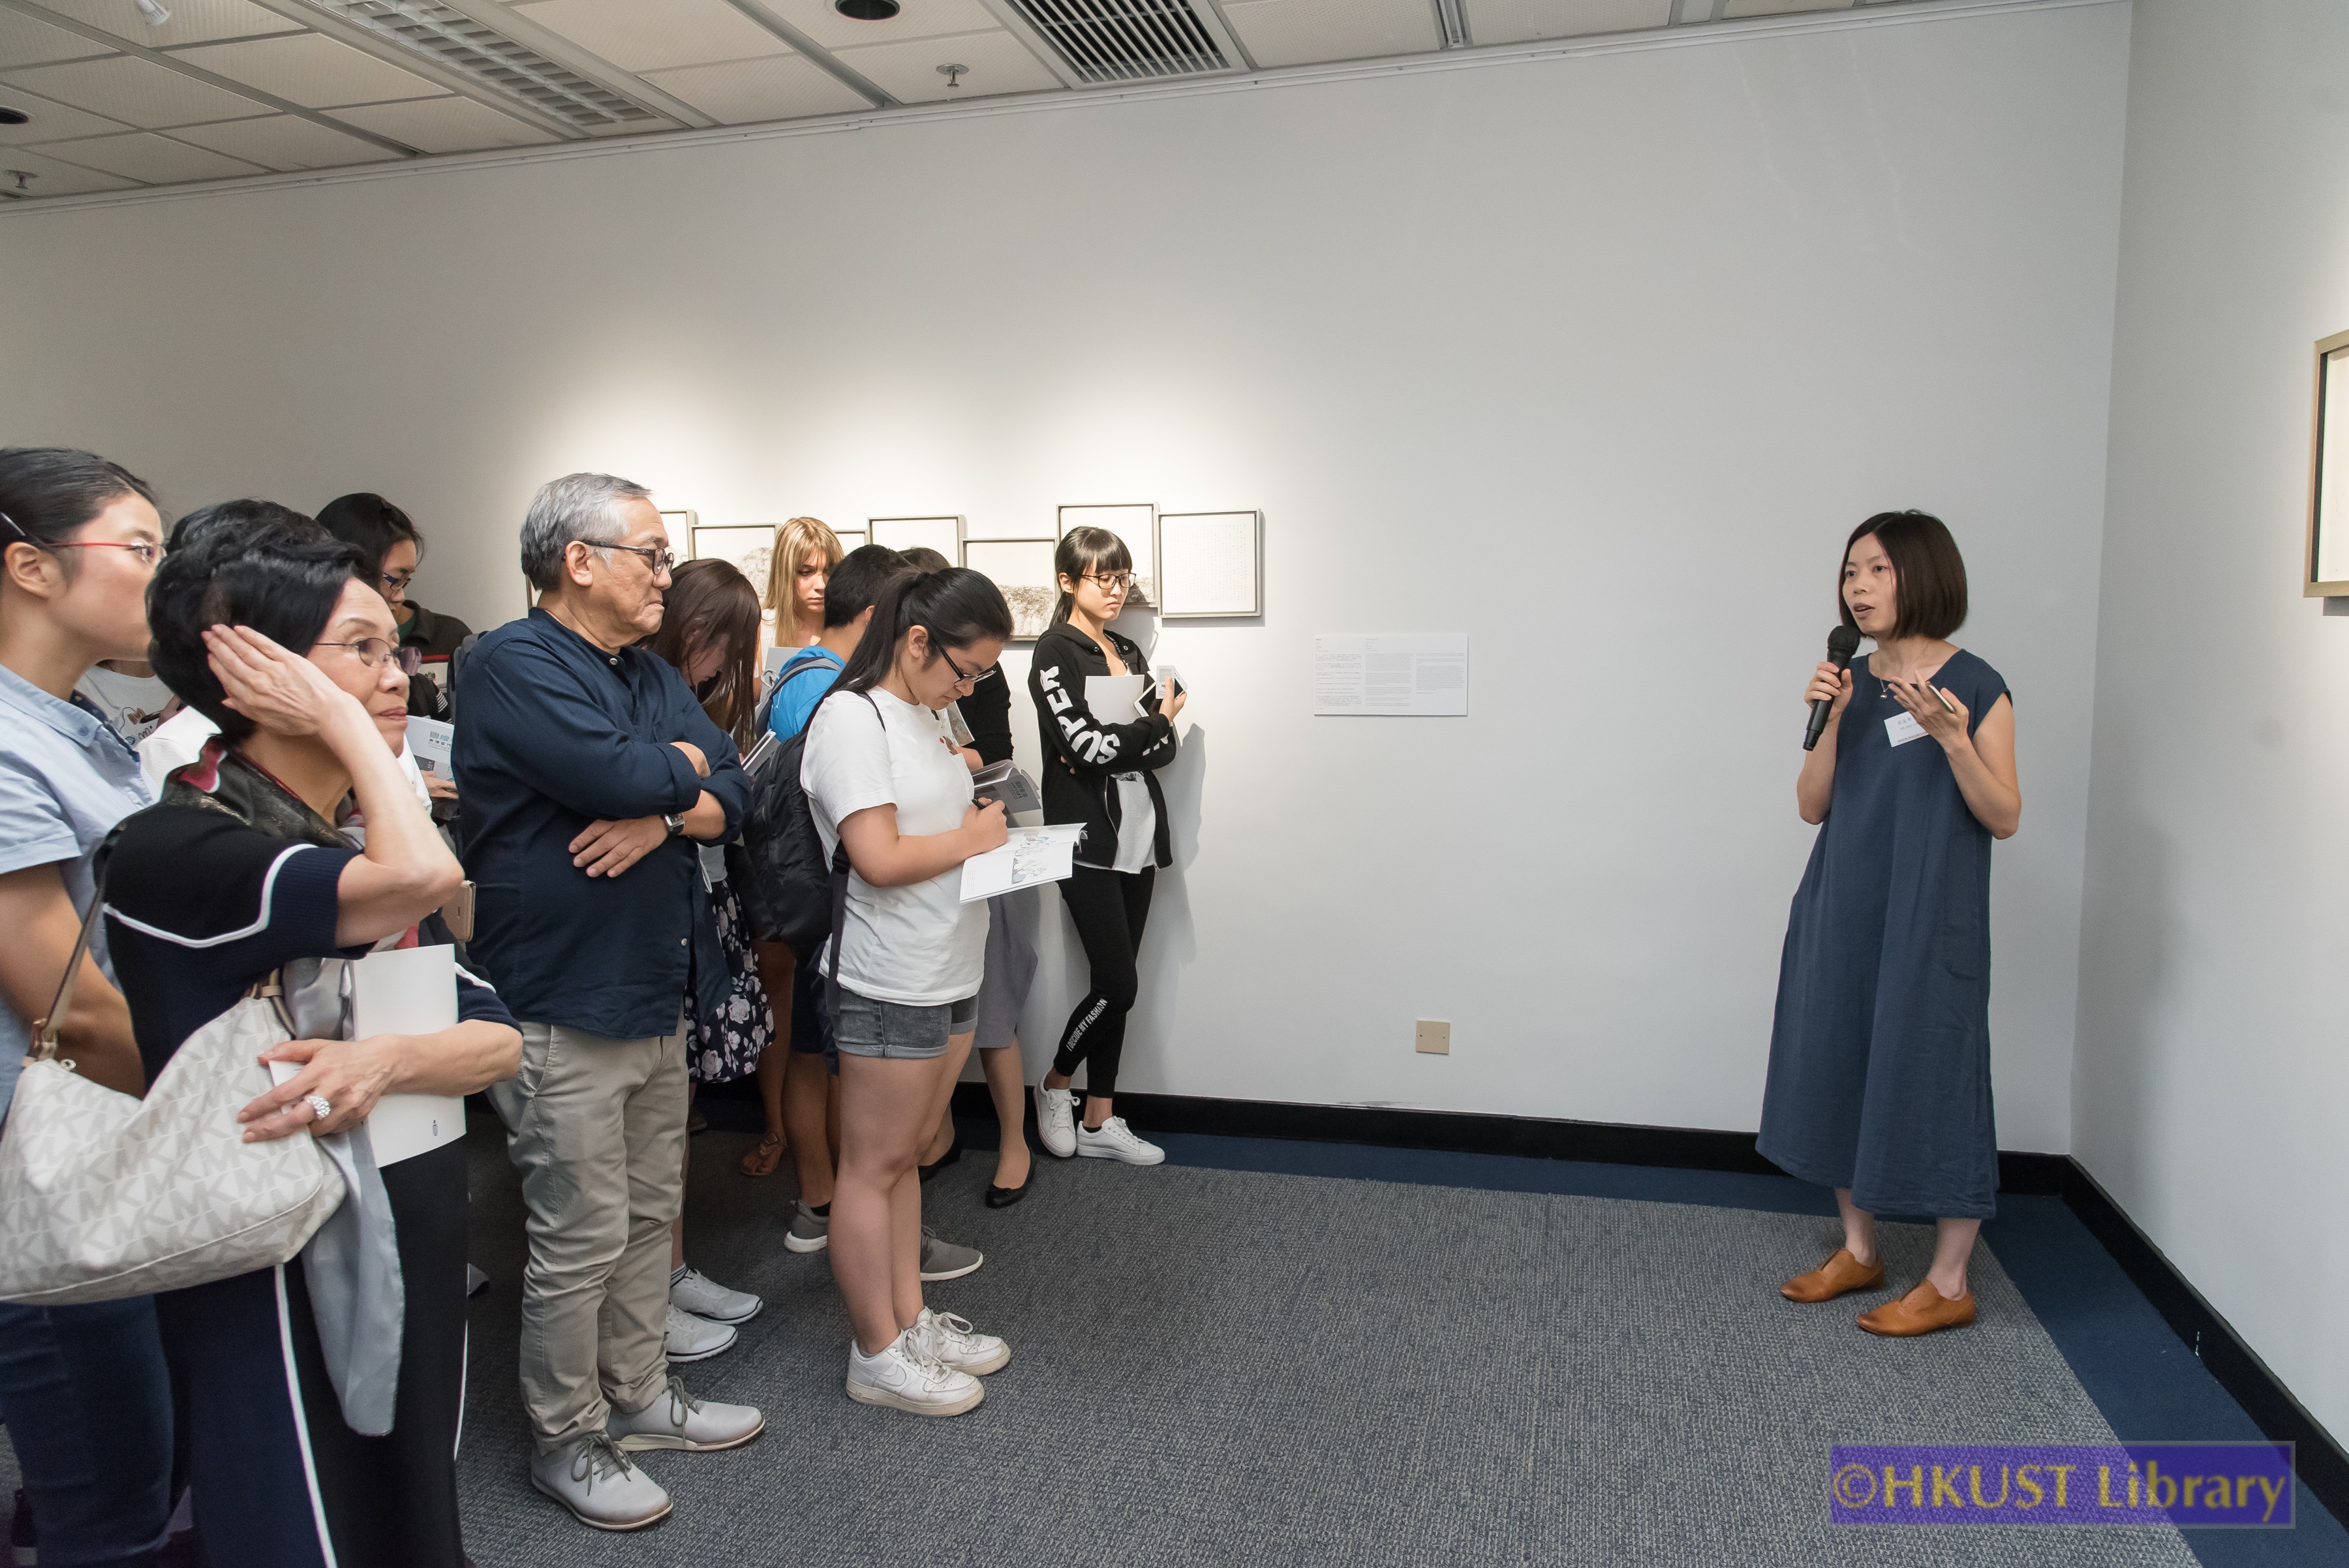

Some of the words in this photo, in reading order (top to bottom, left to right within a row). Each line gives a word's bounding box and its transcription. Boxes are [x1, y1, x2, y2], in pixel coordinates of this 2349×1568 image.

[1040, 666, 1120, 764] SUPER
[1067, 1027, 1082, 1049] DECIDE
[1077, 1019, 1089, 1032] MY
[1085, 998, 1108, 1024] FASHION
